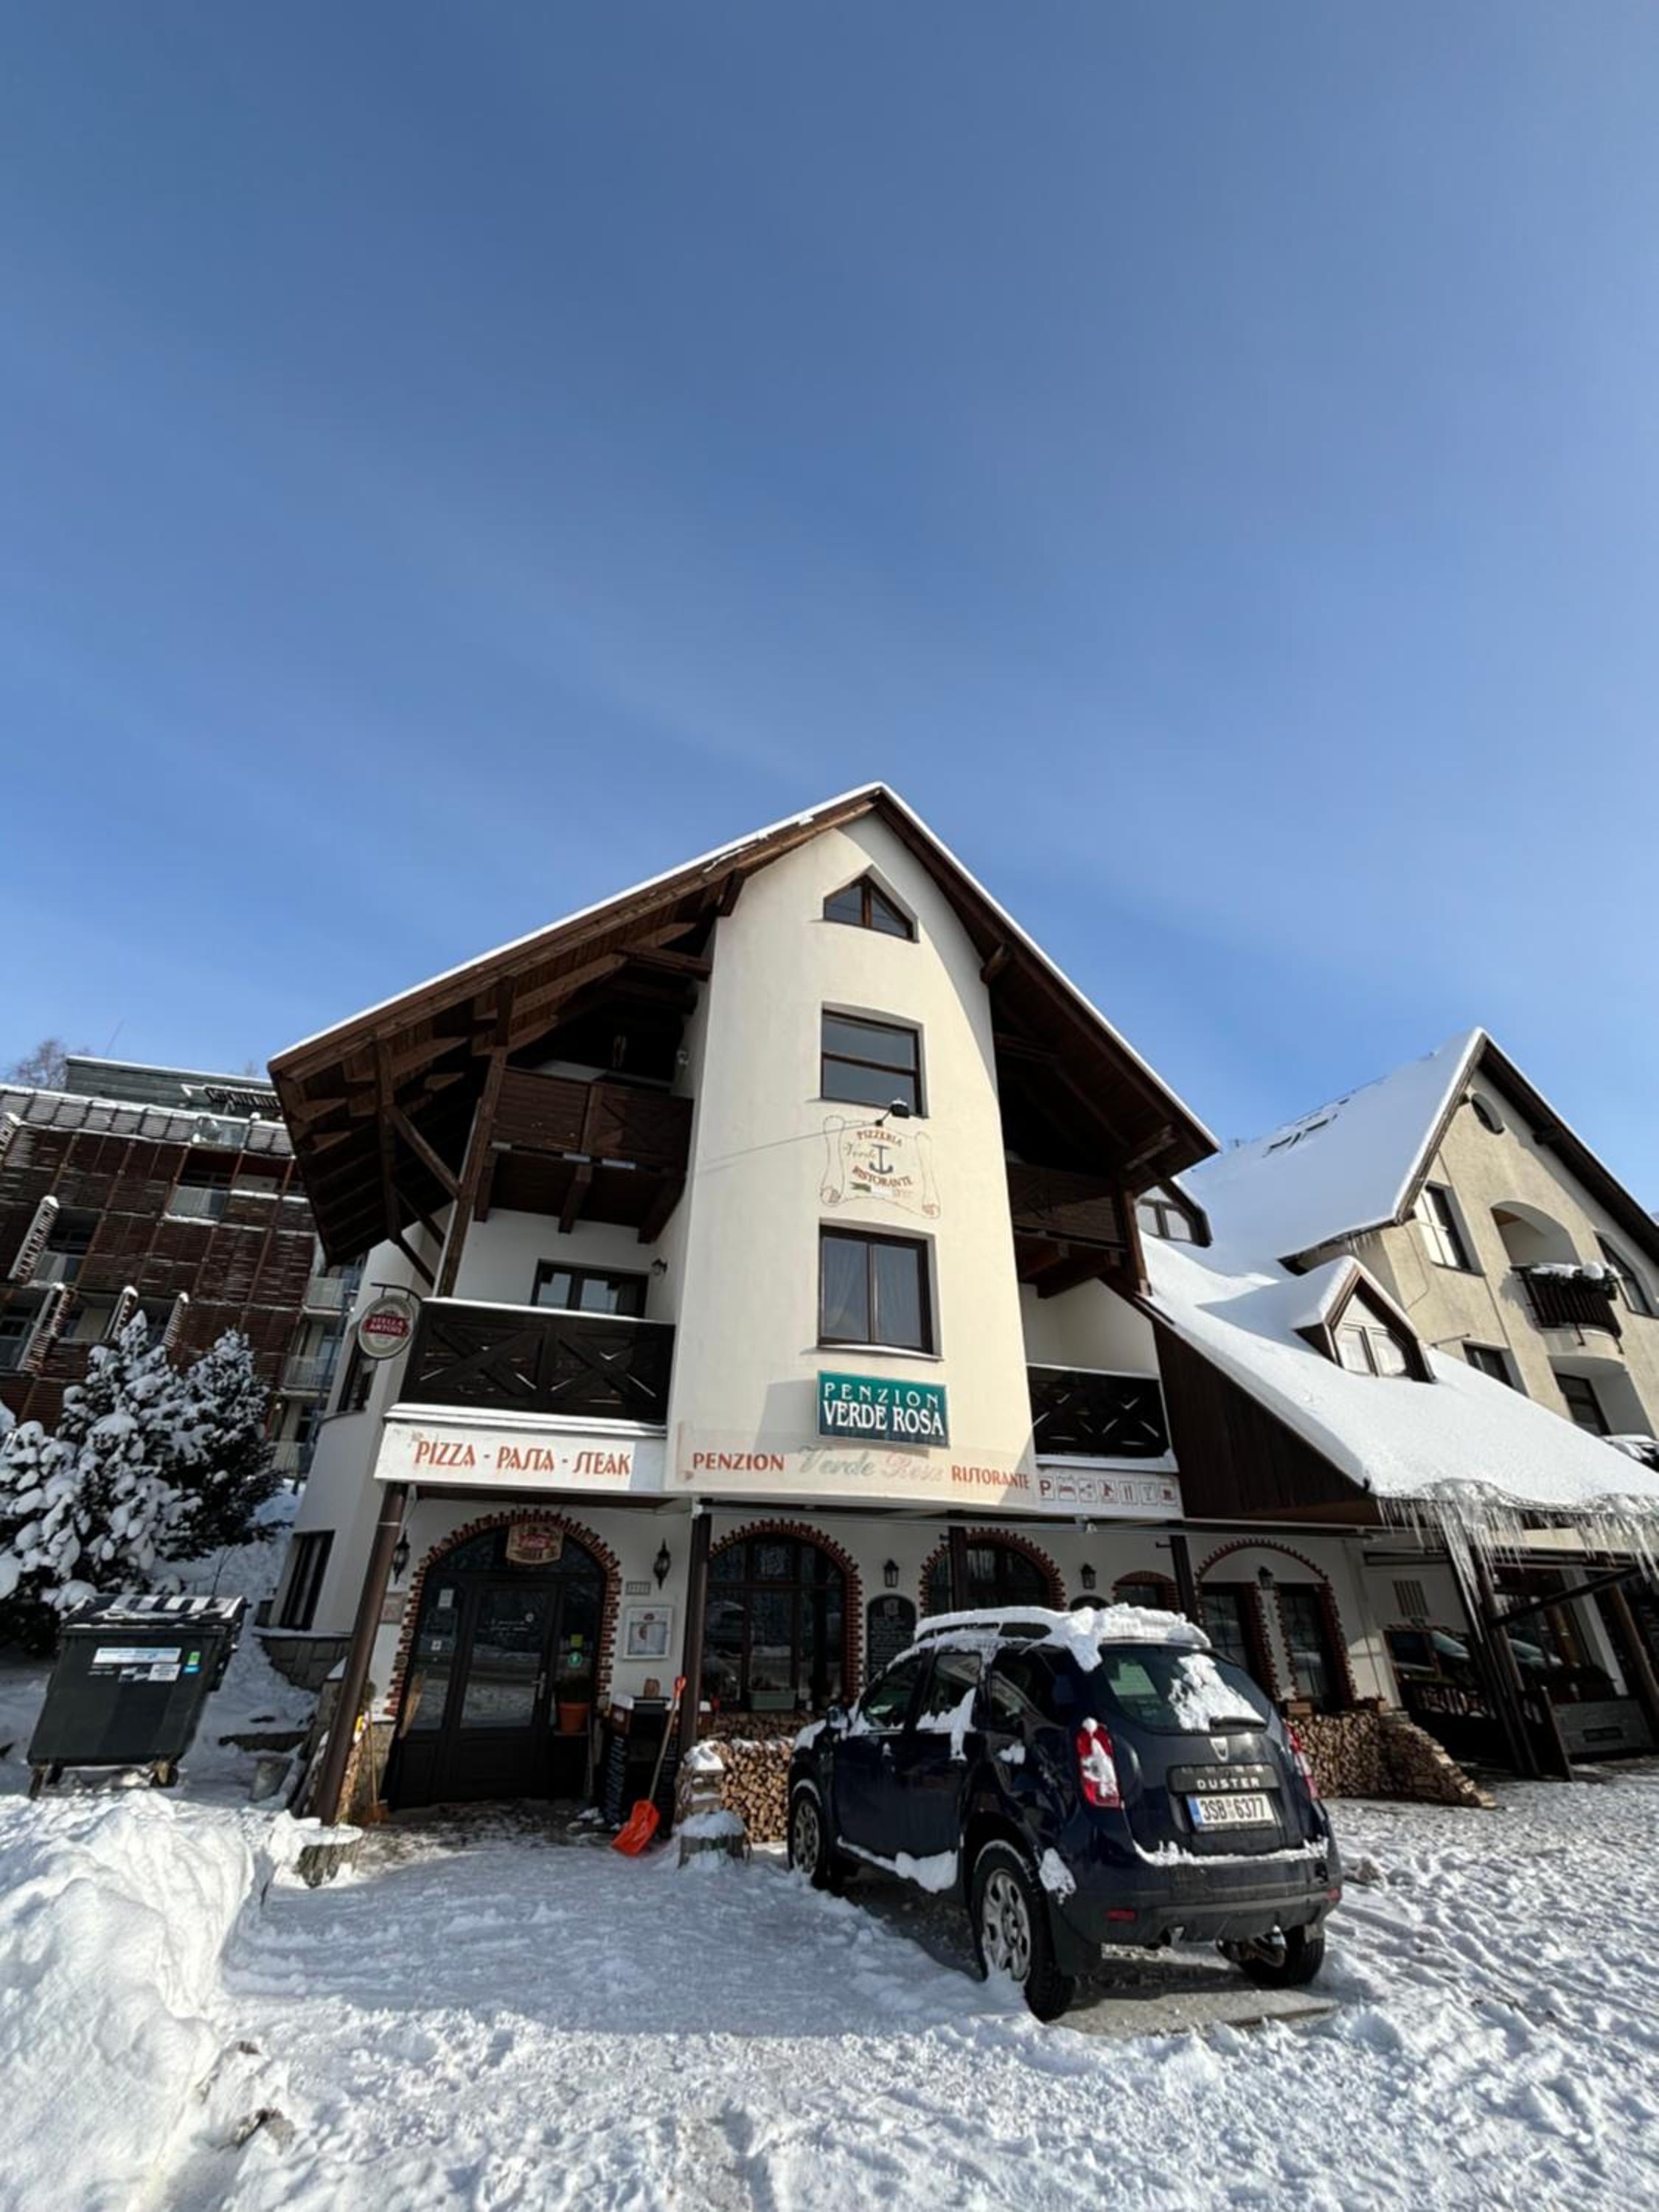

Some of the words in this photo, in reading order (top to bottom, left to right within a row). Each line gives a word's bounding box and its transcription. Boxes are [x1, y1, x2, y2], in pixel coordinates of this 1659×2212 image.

[857, 1130, 902, 1147] PIZZERIA
[852, 1166, 913, 1186] RISTORANTE
[824, 1382, 939, 1409] PENZION
[823, 1400, 888, 1430] VERDE
[892, 1406, 945, 1436] ROSA
[414, 1440, 476, 1466] PIZZA
[496, 1446, 554, 1471] PASTA
[573, 1450, 630, 1475] STEAK
[693, 1452, 785, 1471] PENZION
[950, 1464, 1029, 1489] RISTORANTE
[1196, 1776, 1260, 1790] DUSTER
[1200, 1799, 1228, 1820] 3SB
[1233, 1797, 1266, 1818] 6377
